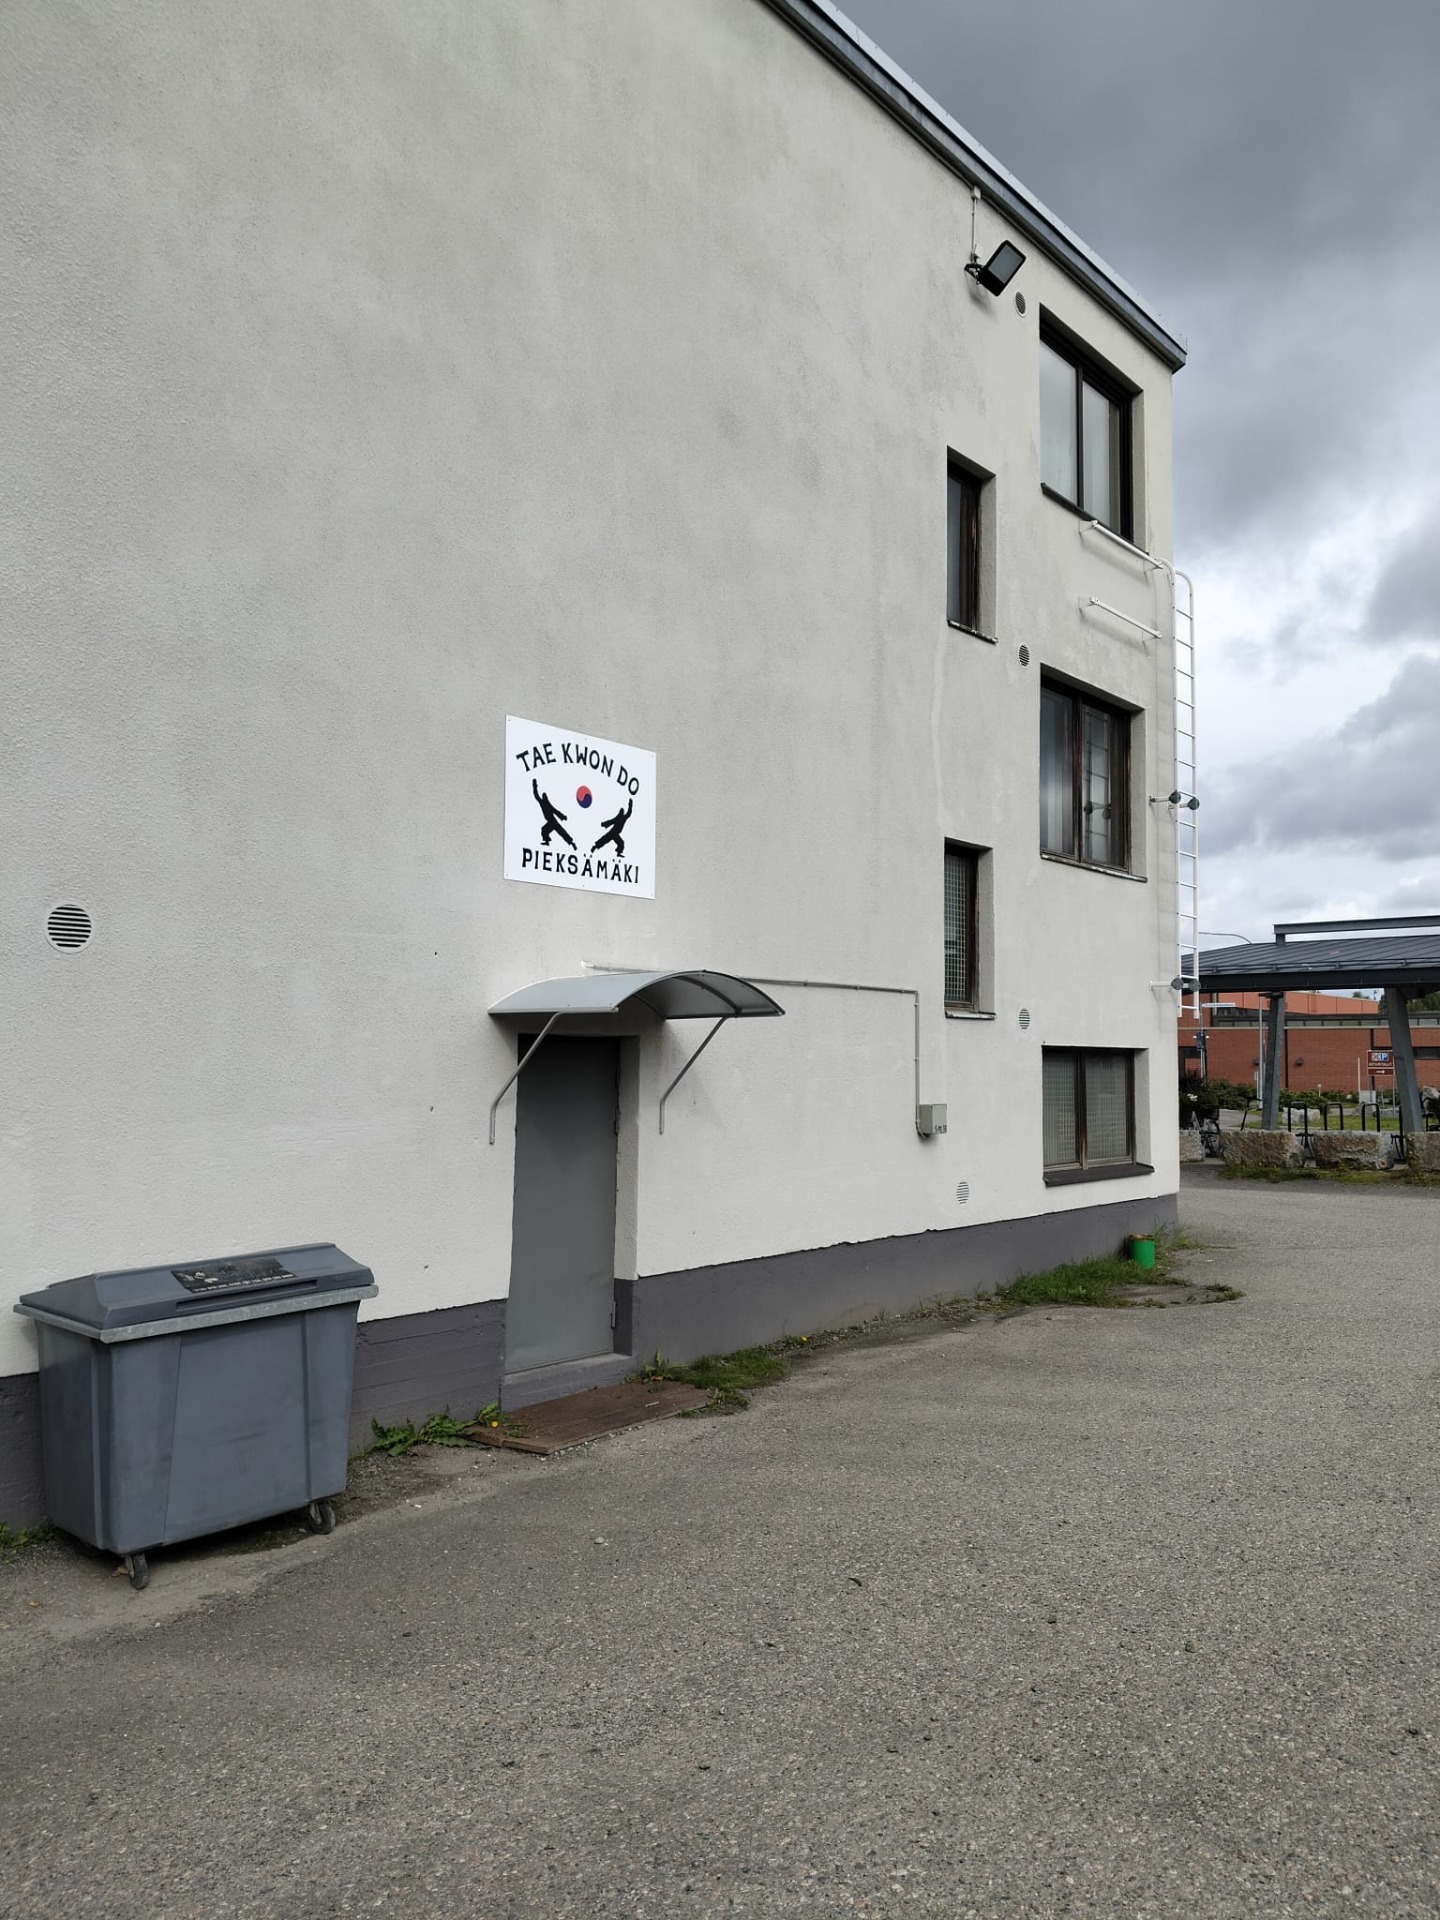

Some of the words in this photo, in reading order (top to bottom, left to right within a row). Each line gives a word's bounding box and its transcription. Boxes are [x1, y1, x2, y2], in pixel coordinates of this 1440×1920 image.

[516, 743, 556, 772] TAE
[561, 742, 613, 777] KWON
[617, 765, 640, 795] DO
[521, 847, 639, 884] PIEKSÄMÄKI
